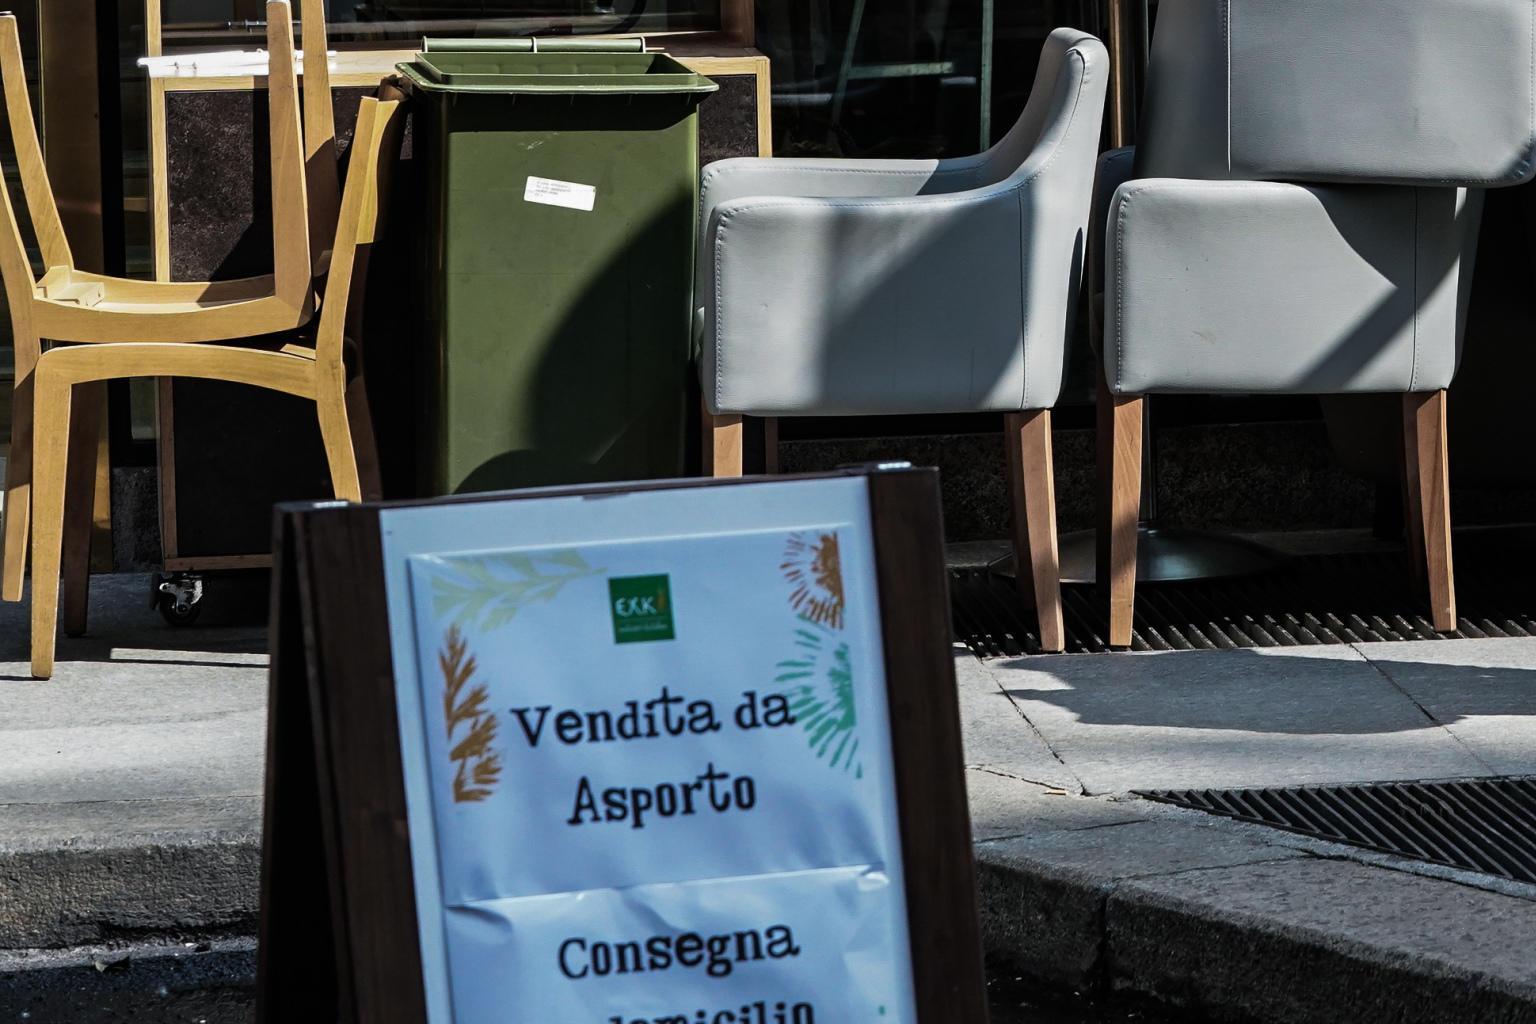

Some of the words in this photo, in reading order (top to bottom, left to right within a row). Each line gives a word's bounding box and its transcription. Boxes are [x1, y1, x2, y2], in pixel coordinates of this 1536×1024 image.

[510, 686, 722, 748] Vendita
[733, 690, 798, 730] da
[566, 762, 756, 829] Asporto
[557, 924, 801, 979] Consegna
